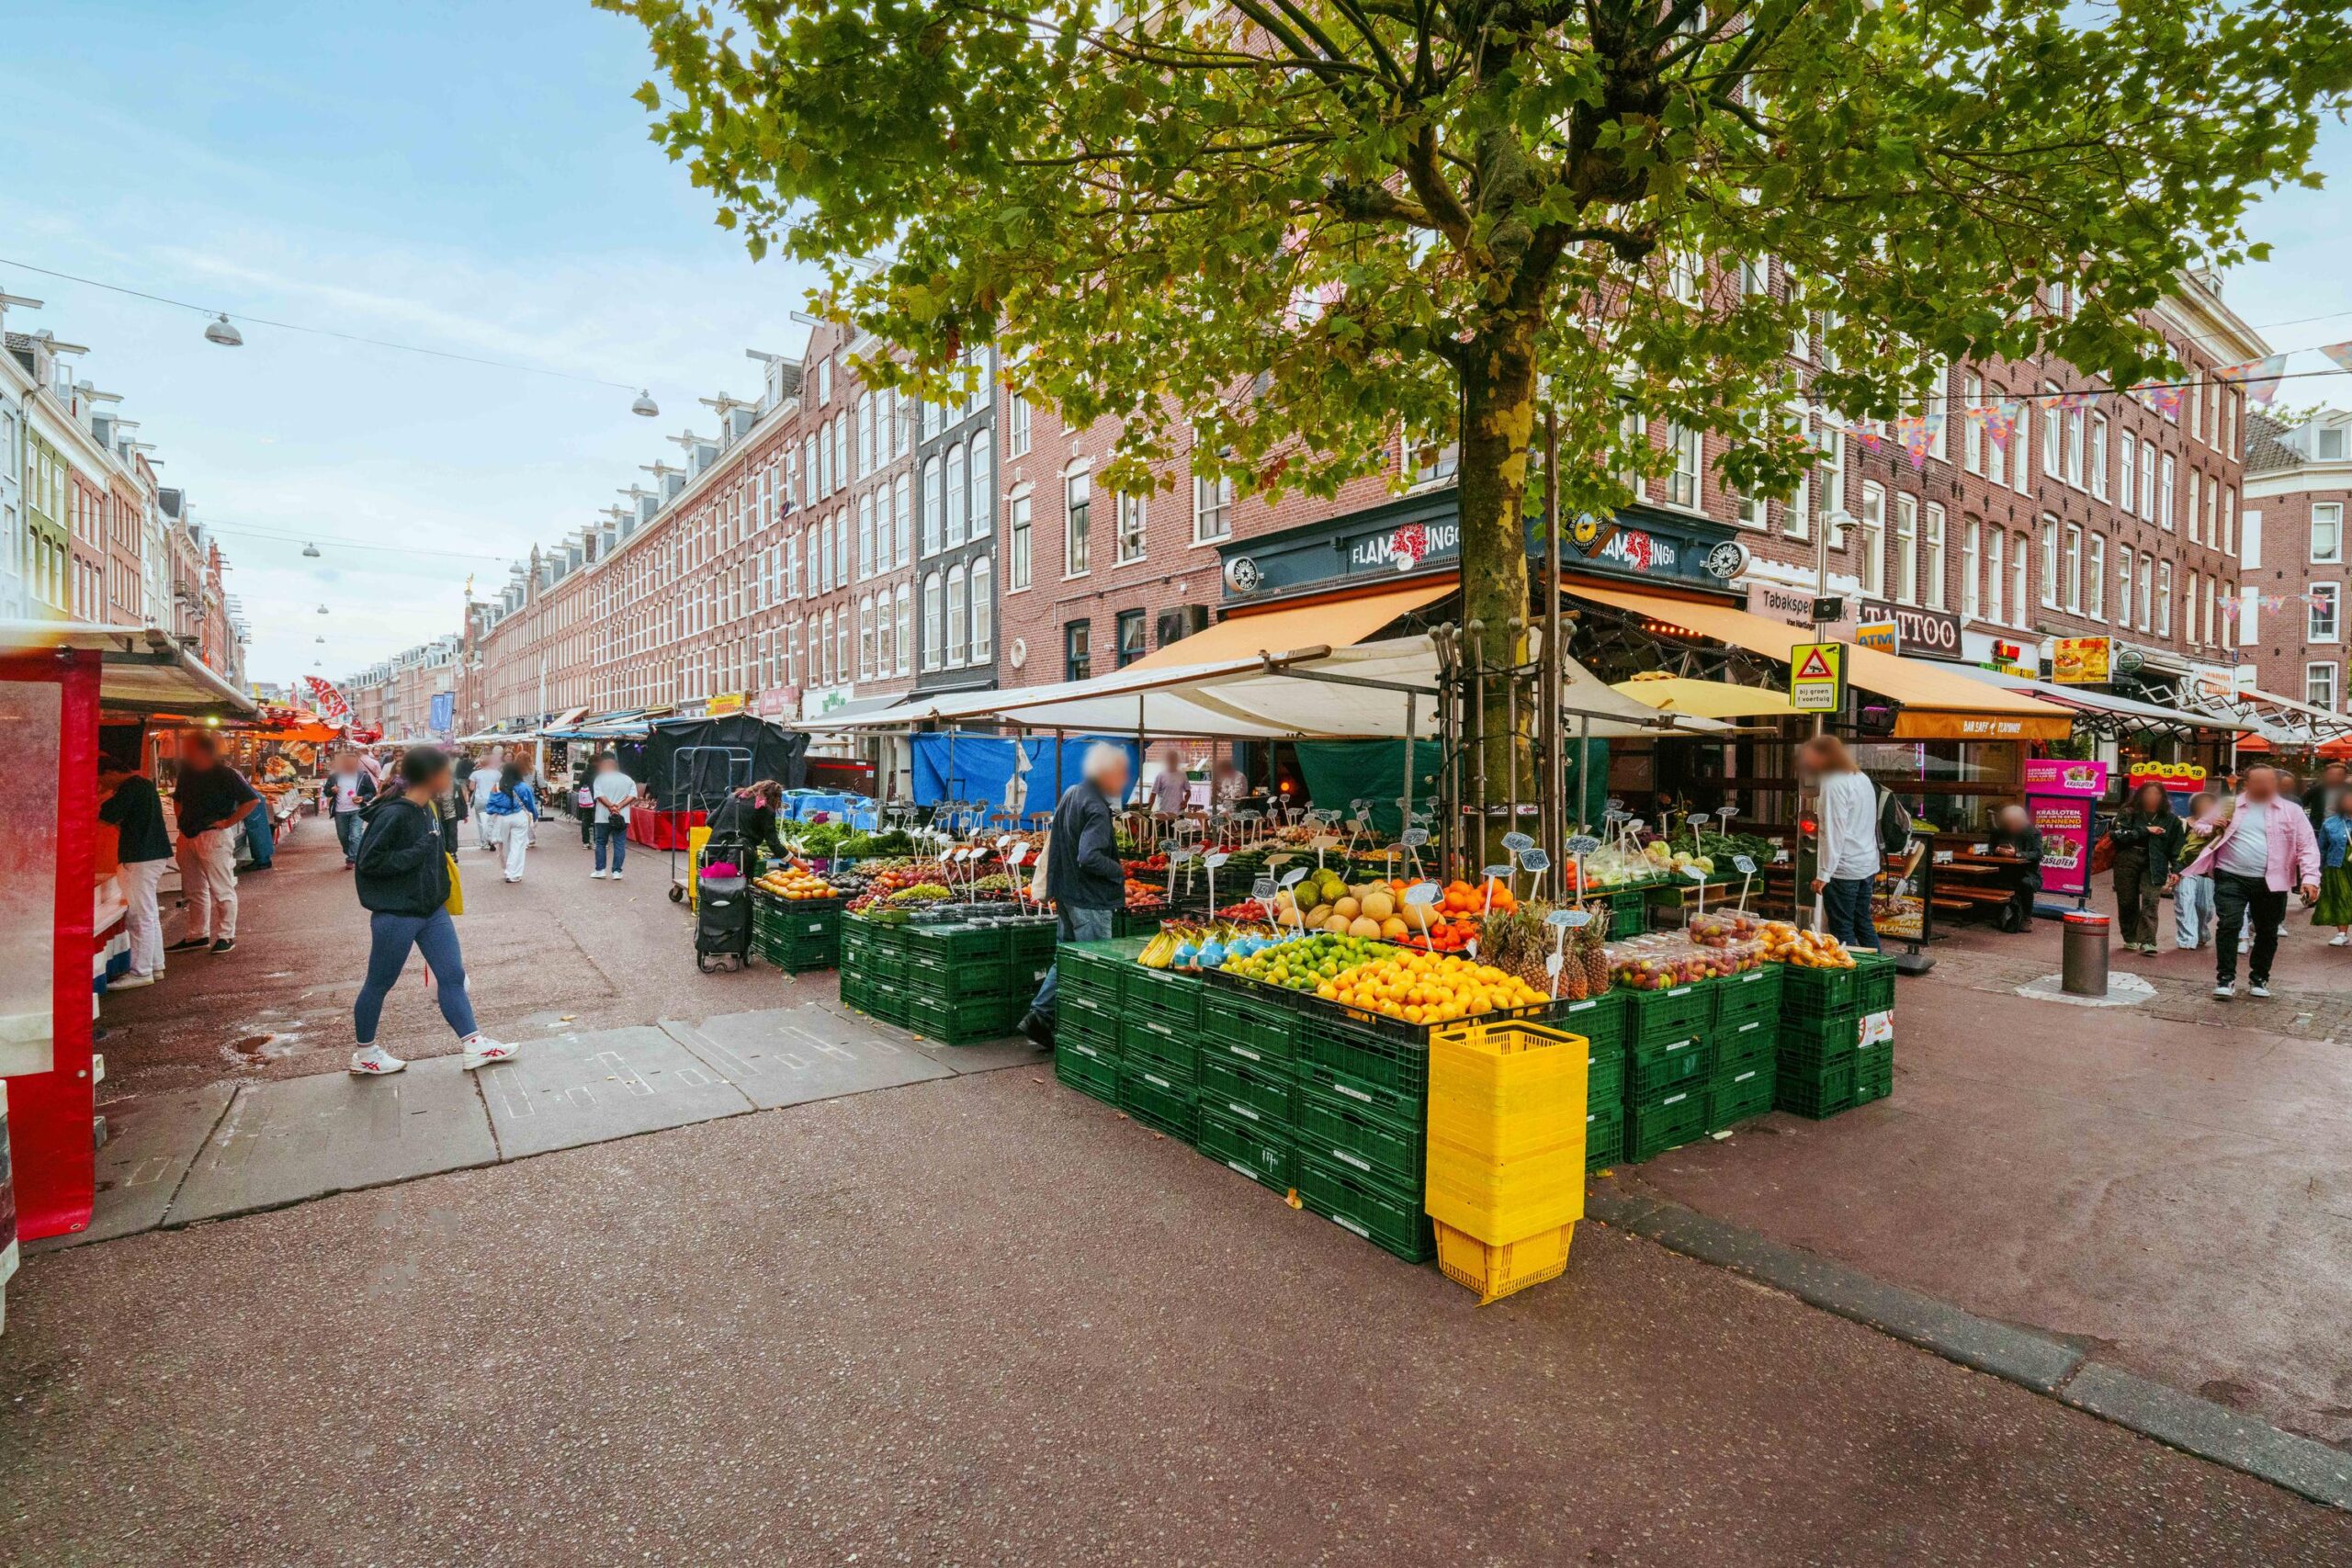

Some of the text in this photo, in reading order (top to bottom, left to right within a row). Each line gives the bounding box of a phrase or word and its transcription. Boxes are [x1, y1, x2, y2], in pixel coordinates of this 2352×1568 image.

[1601, 532, 1675, 568] AMINGO
[1716, 566, 1735, 576] Bier
[1858, 633, 1893, 647] ATM
[2132, 765, 2144, 773] 37
